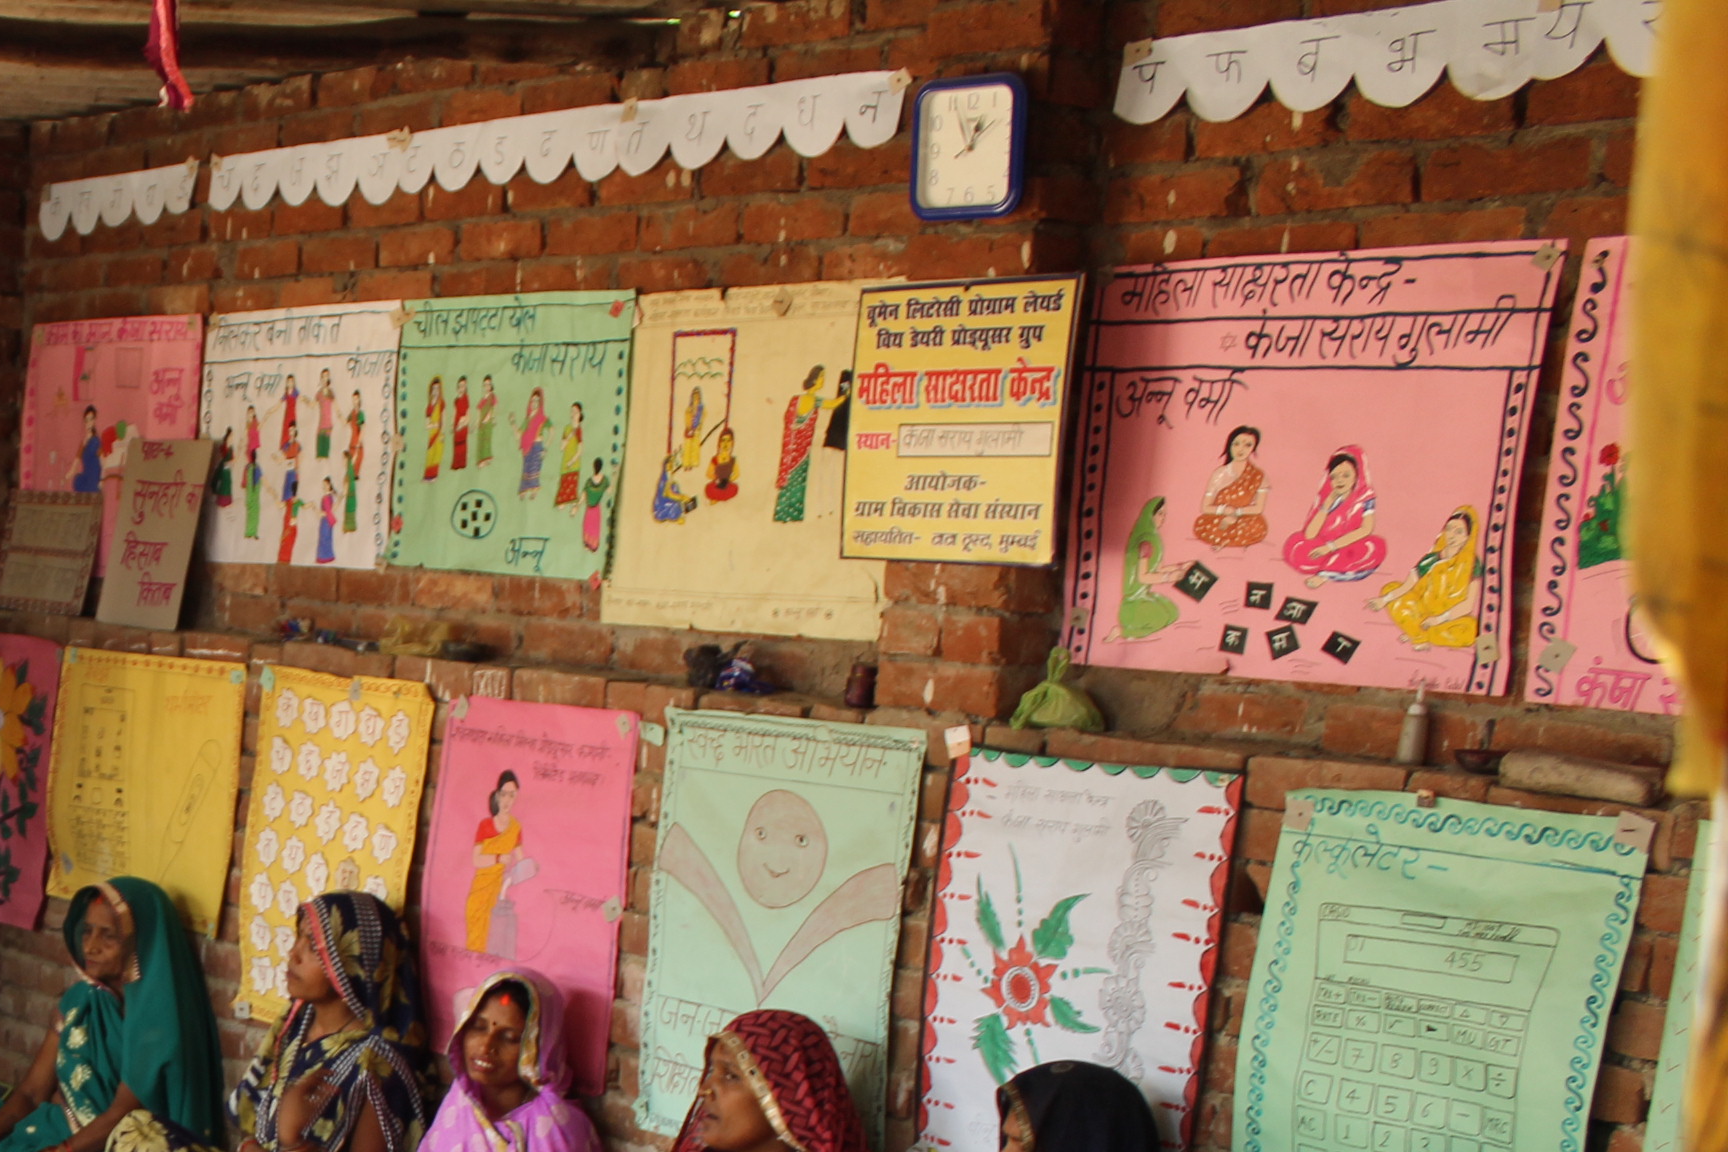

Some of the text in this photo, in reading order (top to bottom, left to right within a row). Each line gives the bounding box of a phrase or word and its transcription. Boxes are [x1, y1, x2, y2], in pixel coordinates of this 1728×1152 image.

[1133, 60, 1166, 94] प
[1206, 49, 1247, 84] फ
[1483, 16, 1537, 56] म
[858, 89, 889, 124] न
[1121, 263, 1206, 316] महिला
[1211, 262, 1323, 309] साक्षरता
[1318, 315, 1397, 360] सराय
[857, 357, 1057, 406] महिला साक्षरता केन्द्र
[890, 496, 944, 519] विकास
[947, 498, 981, 519] सेवा
[121, 531, 169, 571] हिसाब
[1443, 951, 1486, 973] 455
[1351, 1048, 1365, 1065] 7
[1345, 1088, 1361, 1106] 4
[1383, 1095, 1399, 1114] 5
[1422, 1102, 1434, 1119] 6
[1378, 1130, 1392, 1148] 2
